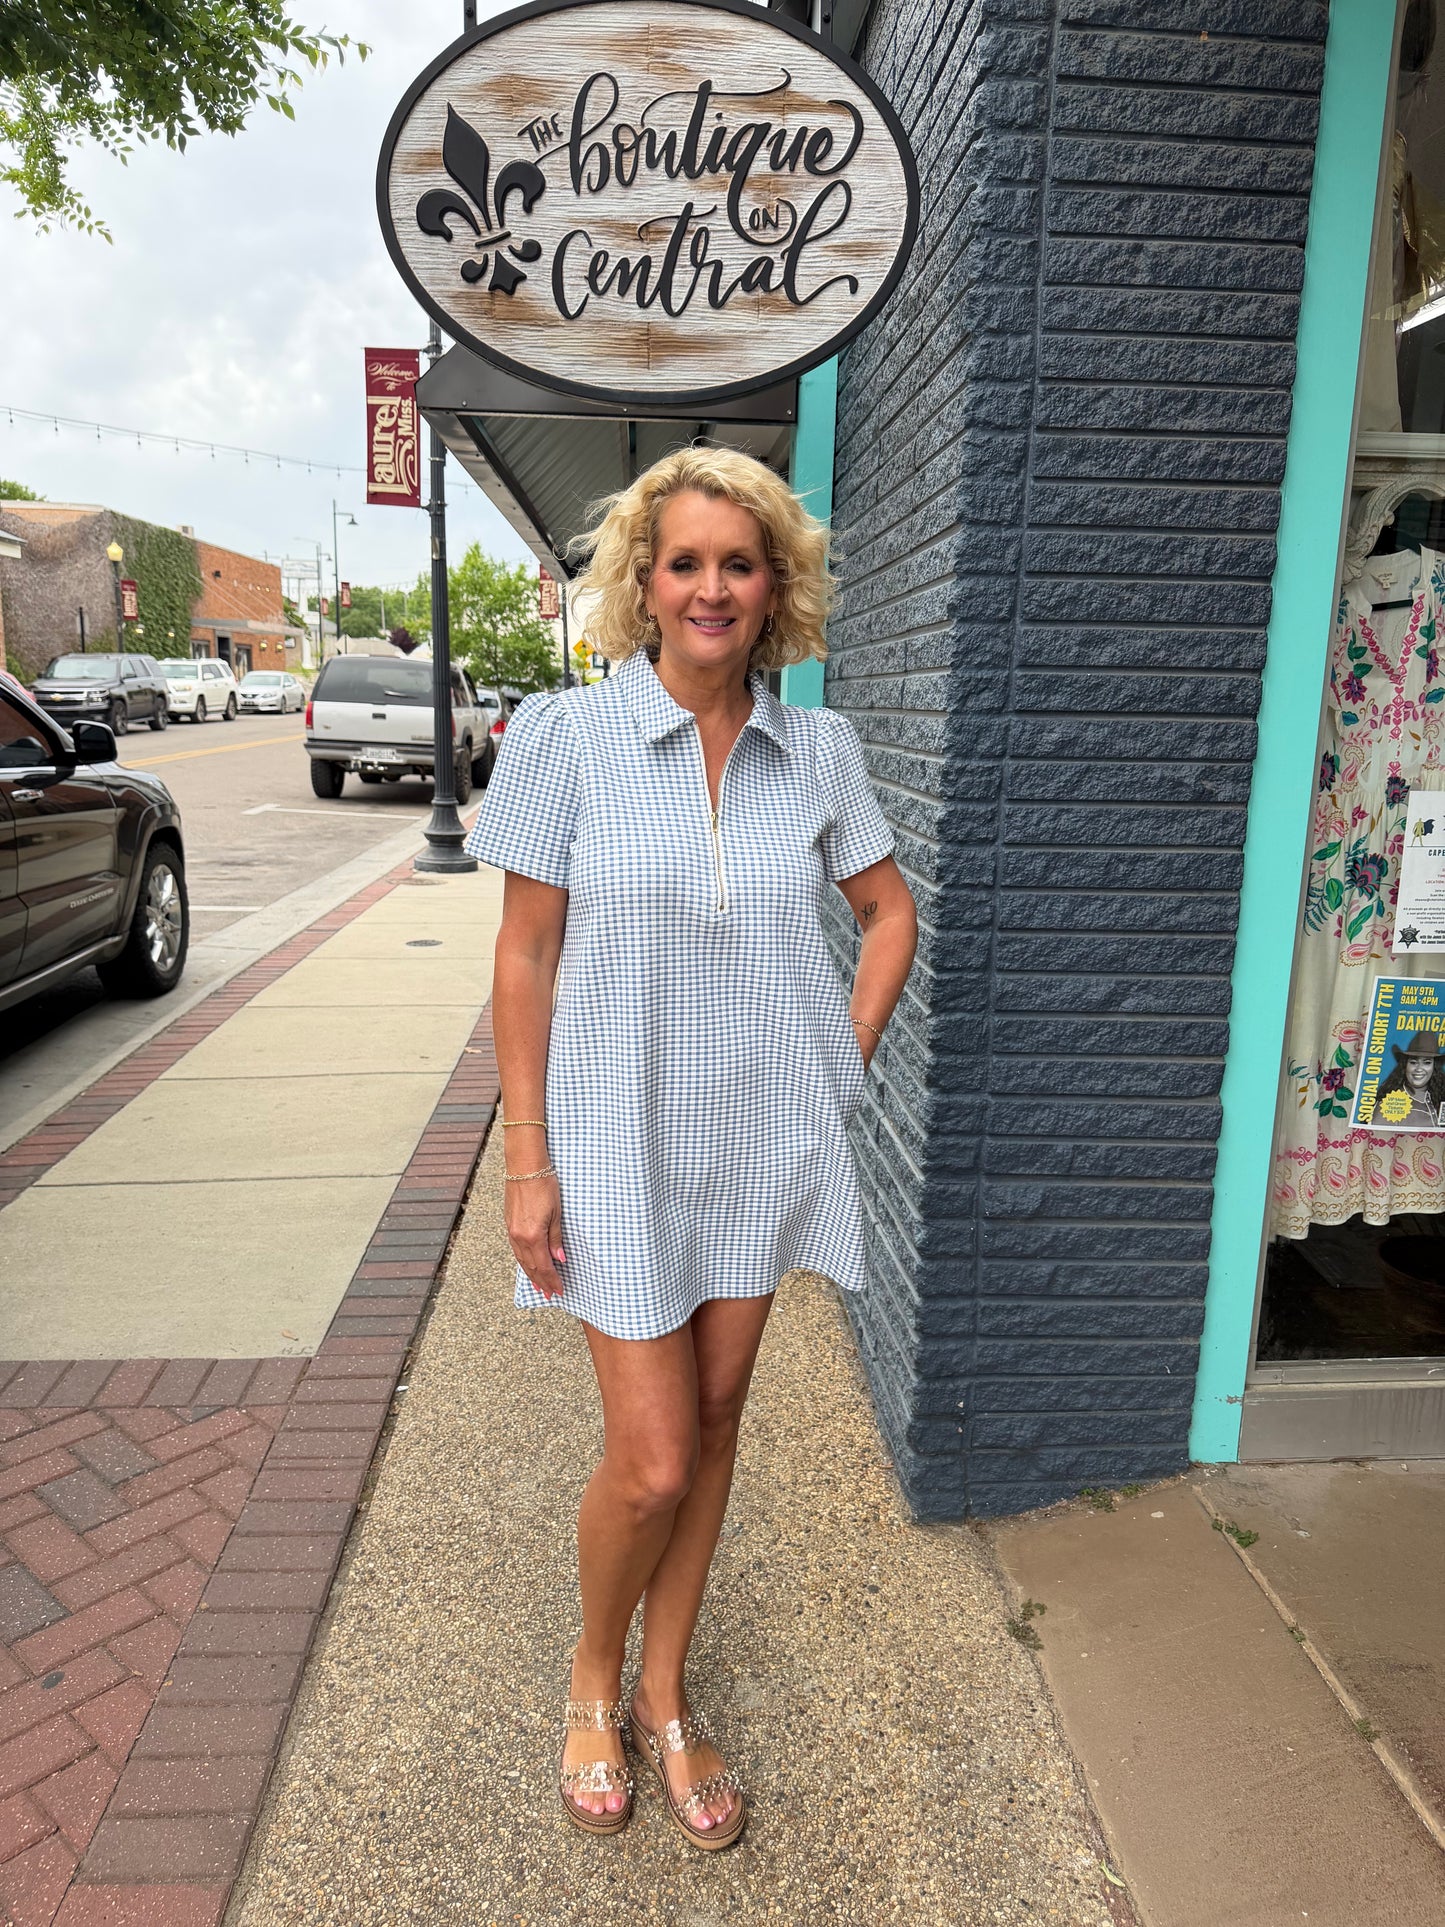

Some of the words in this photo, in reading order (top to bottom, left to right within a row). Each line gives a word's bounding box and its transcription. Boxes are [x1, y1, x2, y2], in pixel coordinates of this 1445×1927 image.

[518, 112, 564, 151] THE
[536, 68, 864, 245] boutique
[749, 205, 779, 231] ON
[551, 179, 858, 320] Central
[367, 395, 412, 496] Laurel
[1376, 984, 1395, 1008] 7TH
[1400, 995, 1418, 1005] 9AM
[1402, 986, 1419, 995] MAY
[1419, 987, 1434, 996] 9TH
[1369, 1010, 1391, 1054] SHORT
[1396, 1015, 1445, 1032] DANICA
[1366, 1057, 1383, 1074] ON
[1357, 1077, 1379, 1124] SOCIAL
